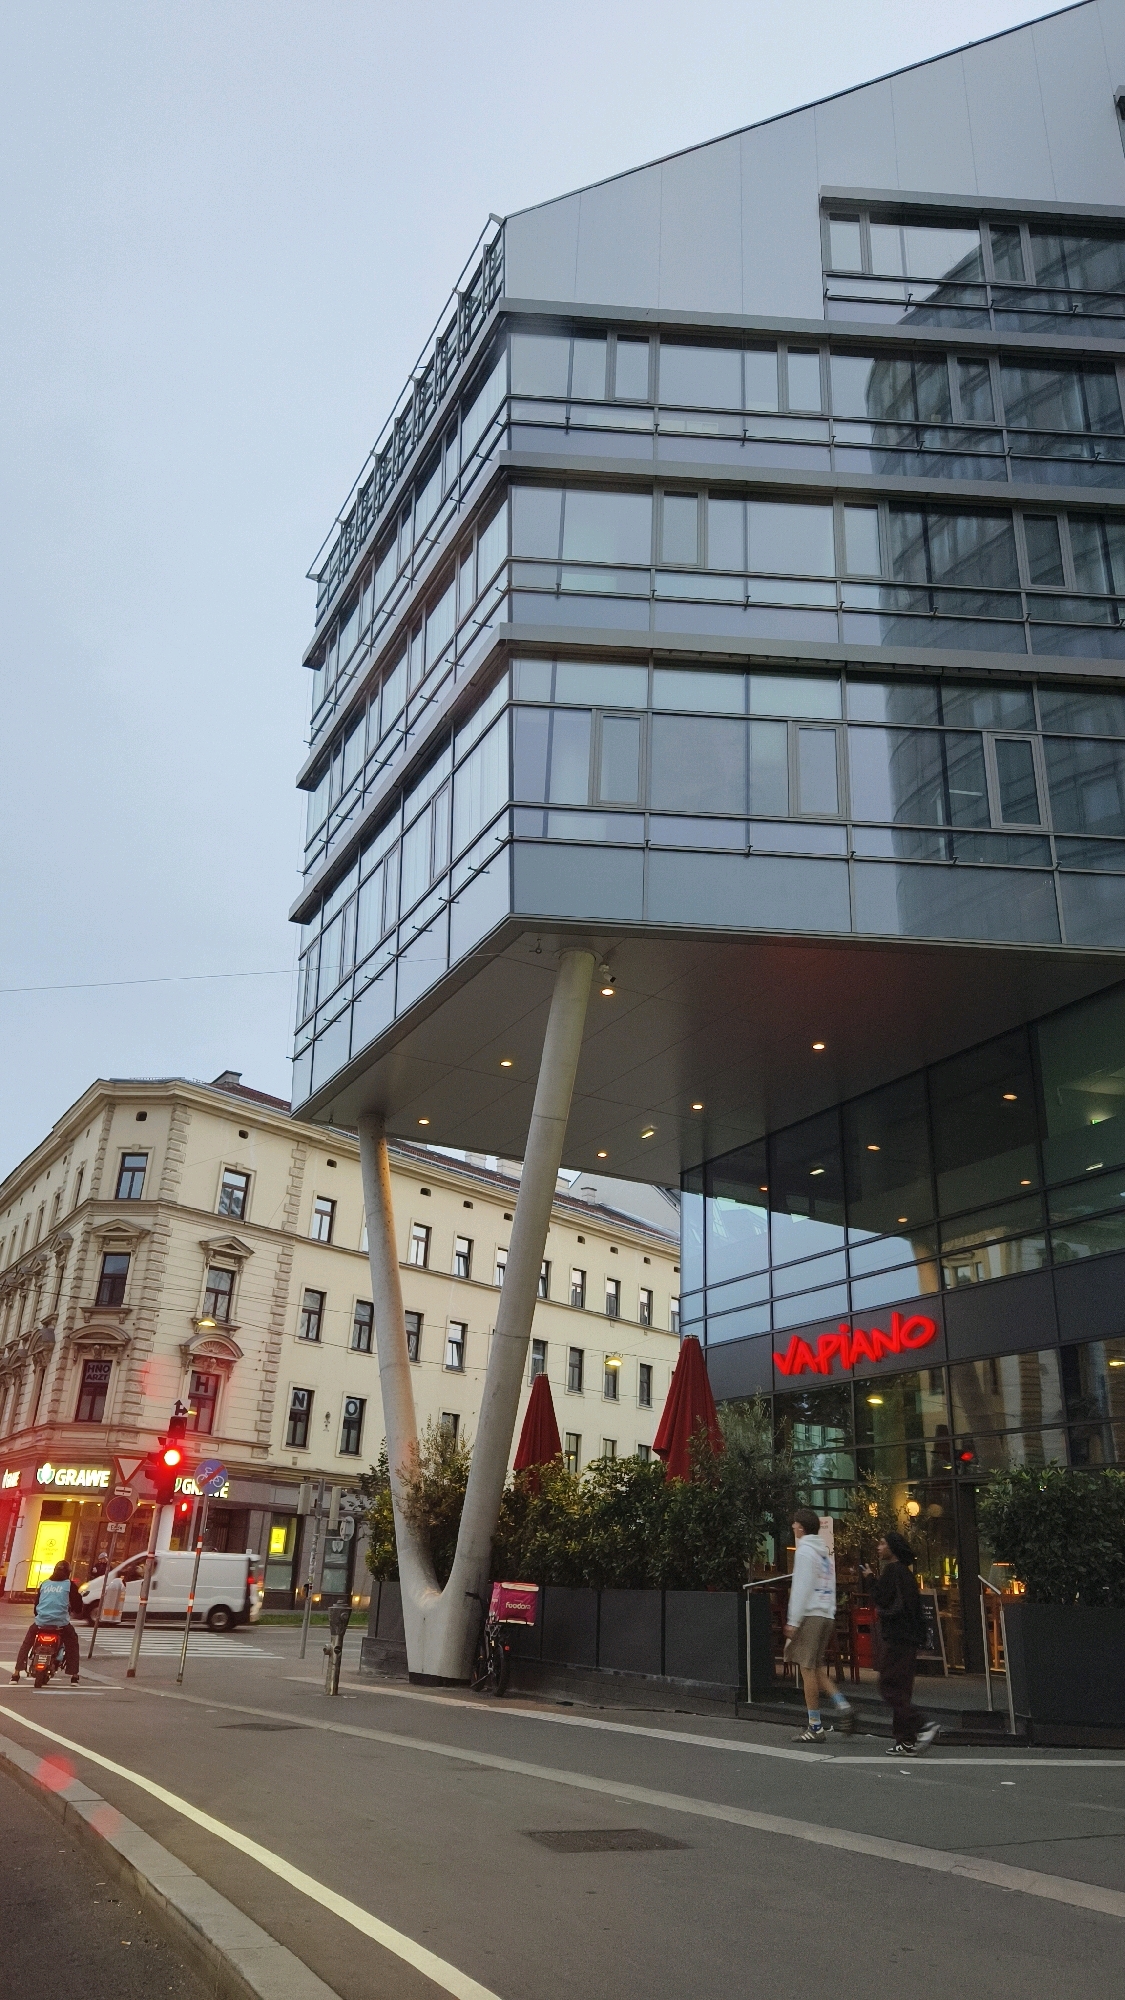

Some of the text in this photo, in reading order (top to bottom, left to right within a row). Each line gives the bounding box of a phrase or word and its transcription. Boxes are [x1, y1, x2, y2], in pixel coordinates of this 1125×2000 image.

[87, 1364, 110, 1373] HNO
[85, 1373, 109, 1381] ARZT
[195, 1375, 210, 1393] H
[292, 1391, 306, 1409] N
[55, 1469, 111, 1488] GRAWE
[182, 1478, 229, 1498] GRE
[43, 1585, 63, 1593] Wolt
[505, 1601, 532, 1610] foodora
